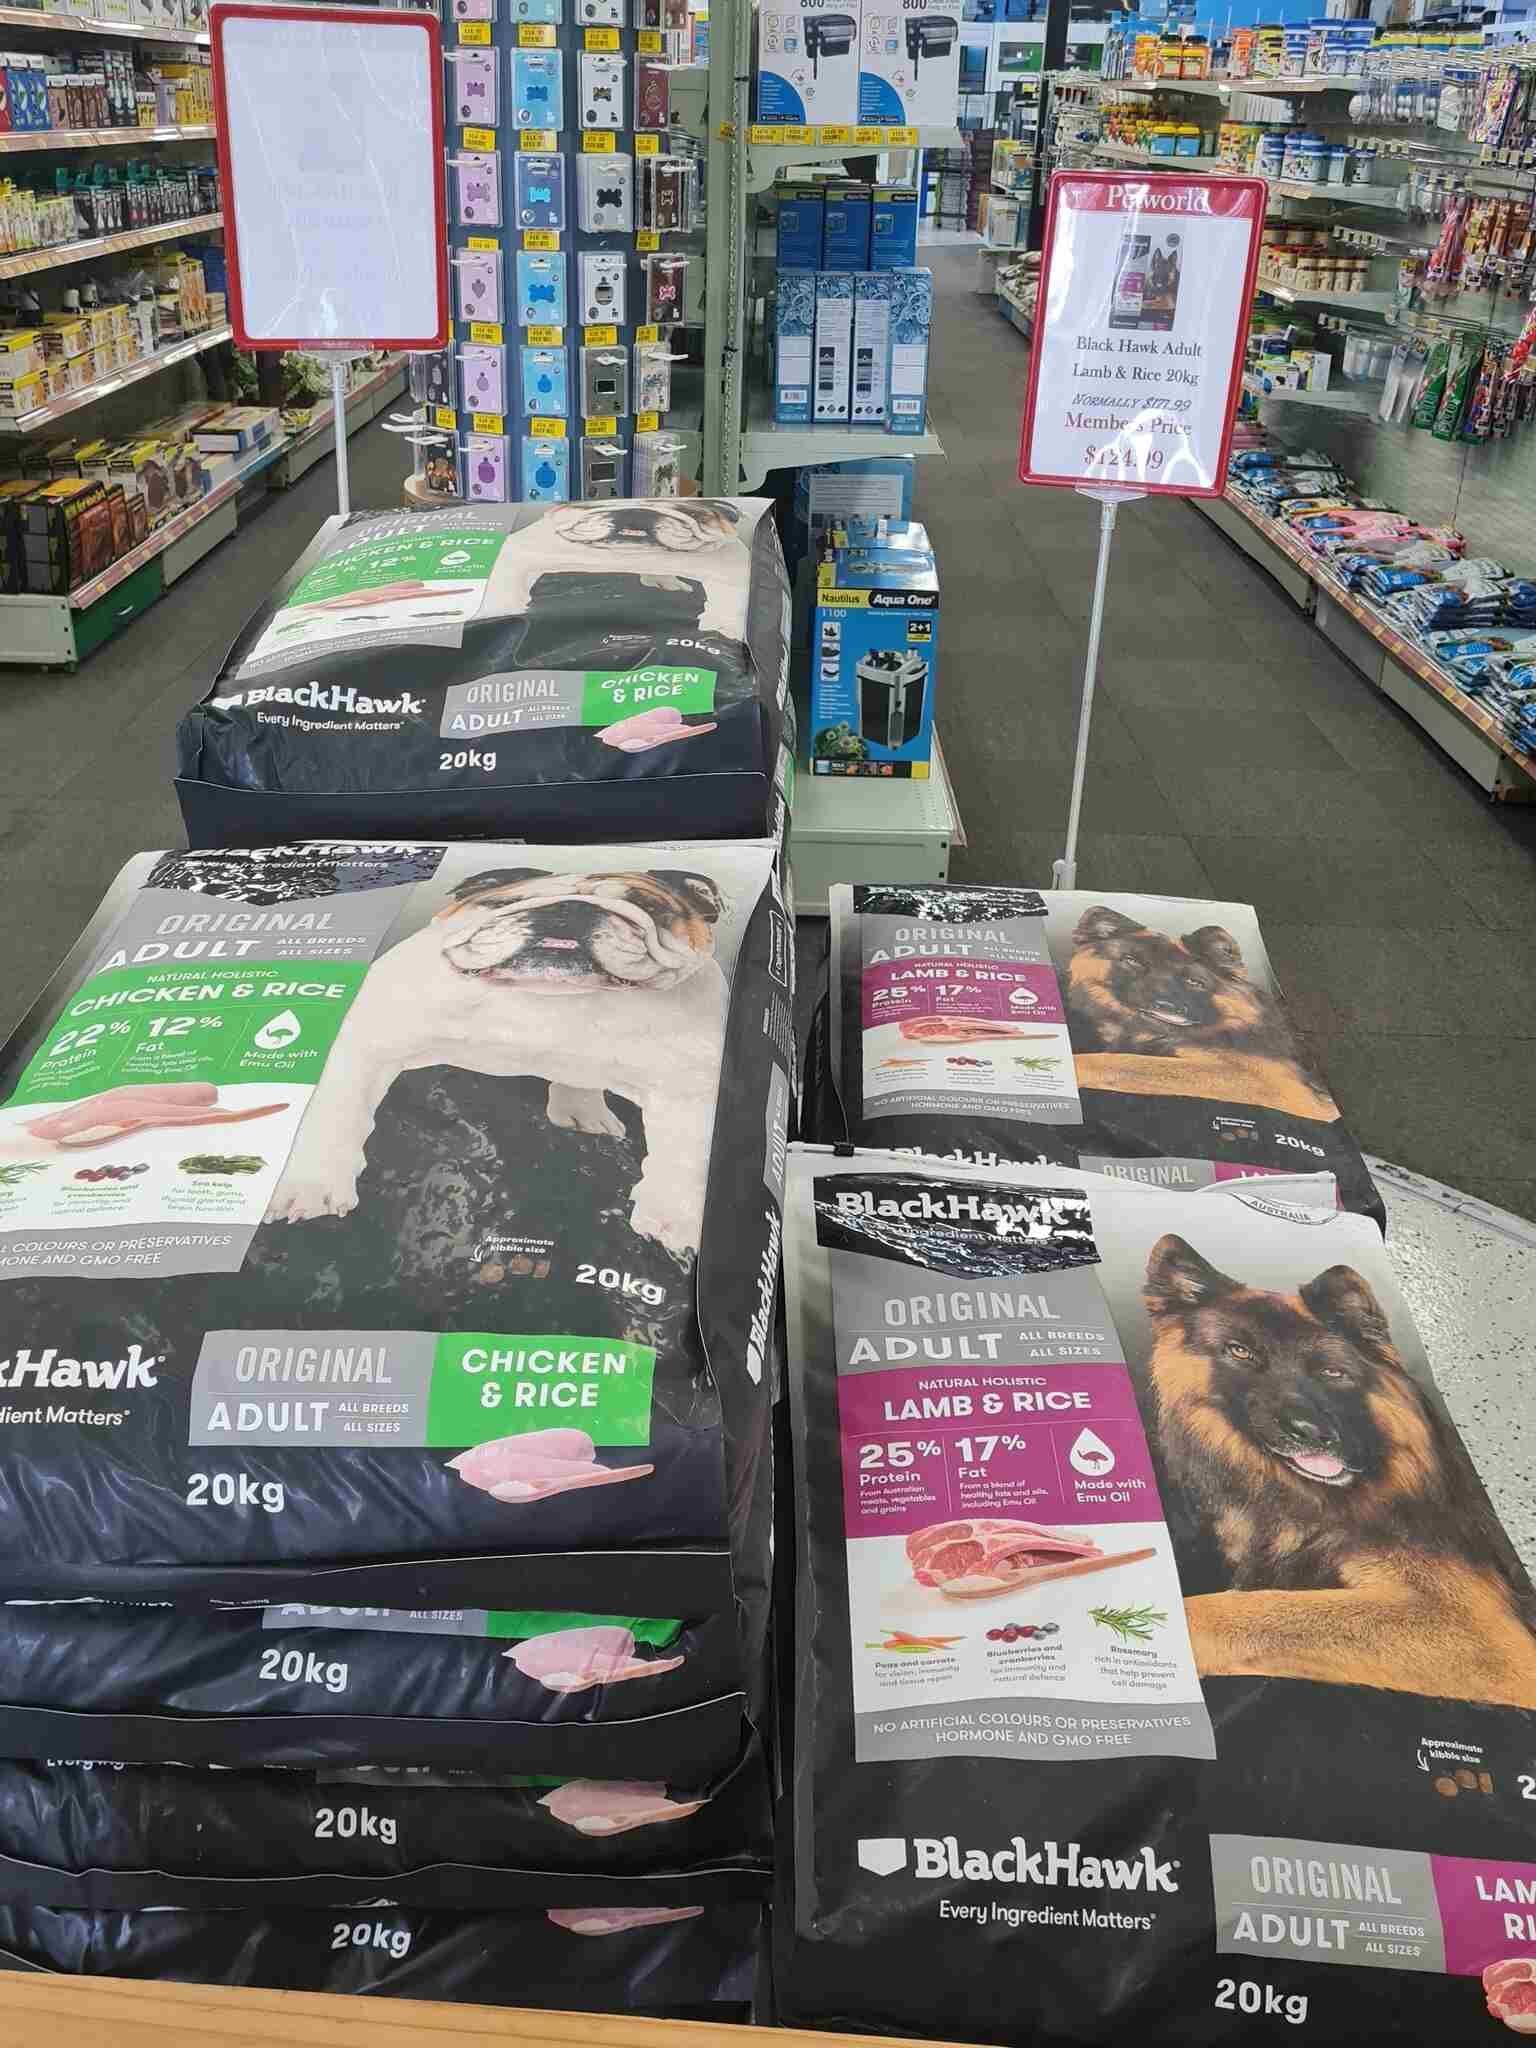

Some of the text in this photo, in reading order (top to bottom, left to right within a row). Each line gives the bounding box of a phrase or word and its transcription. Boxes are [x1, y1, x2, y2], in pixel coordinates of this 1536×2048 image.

[1076, 336, 1202, 357] Black Hawk Adult
[1072, 363, 1200, 386] Lamb & Rice 20kg
[1064, 412, 1192, 435] Membes Price
[440, 537, 497, 546] RICE
[821, 592, 861, 604] Nautilus
[872, 594, 905, 607] Aqua
[909, 622, 931, 632] 2+1
[665, 637, 721, 655] 20kg
[601, 671, 699, 690] CHICKEN
[245, 680, 423, 715] BlackHawk
[466, 679, 560, 705] ORIGINAL
[612, 684, 683, 703] & RICE
[256, 712, 401, 731] Every Ingredient Matters
[450, 709, 524, 732] ADULT
[439, 749, 497, 772] 20kg
[324, 860, 389, 869] matters
[155, 912, 336, 935] ORIGINAL
[895, 927, 1014, 945] ORIGINAL
[97, 935, 368, 975] ADULT ALL BREEDS
[277, 947, 354, 956] ALL SIZES
[869, 943, 973, 965] ADULT
[147, 969, 280, 984] NATURAL HOLISTIC
[890, 968, 1027, 982] LAMB & RICE
[70, 982, 348, 1017] CHICKEN & RICE
[872, 984, 927, 999] 25%
[935, 984, 982, 996] 17%
[871, 998, 912, 1009] Protein
[148, 1015, 224, 1038] 12%
[48, 1019, 133, 1058] 22%
[135, 1040, 165, 1054] Fat
[39, 1047, 97, 1071] Protein
[239, 1059, 297, 1069] Emu Oil
[243, 1049, 319, 1060] Made with
[1274, 1133, 1326, 1157] 20kg
[1103, 1163, 1194, 1185] ORIGINAL
[835, 1190, 1069, 1226] BlackHawk
[12, 1240, 88, 1253] COLOURS
[91, 1240, 115, 1251] OR
[119, 1234, 233, 1251] PRESERVATIVES
[484, 1235, 555, 1247] Approximate
[40, 1254, 76, 1265] AND
[79, 1254, 122, 1266] GMO
[124, 1253, 161, 1265] FREE
[575, 1263, 668, 1306] 20kg
[884, 1290, 1061, 1326] ORIGINAL
[849, 1330, 1105, 1365] ADULT ALL BREEDS
[1029, 1345, 1102, 1358] ALL SIZES
[235, 1346, 393, 1385] ORIGINAL
[461, 1347, 627, 1376] CHICKEN
[918, 1376, 1047, 1390] NATURAL HOLISTIC
[480, 1382, 599, 1408] & RICE
[884, 1391, 1093, 1421] LAMB & RICE
[45, 1405, 125, 1427] Matters
[206, 1401, 409, 1432] ADULT ALL BREEDS
[343, 1421, 401, 1433] ALL SIZES
[859, 1439, 941, 1470] 25%
[954, 1434, 1026, 1463] 17%
[859, 1470, 921, 1487] Protein
[958, 1466, 988, 1479] Fat
[185, 1472, 286, 1515] 20kg
[1073, 1477, 1146, 1491] Made with
[1076, 1491, 1130, 1504] Emu Oil
[409, 1609, 430, 1620] ALL
[259, 1648, 349, 1694] 20kg
[873, 1711, 1192, 1734] NO ARTIFICIAL COLOURS OR PRESERVATIVES
[935, 1729, 1133, 1747] HORMONE AND GMO FREE
[1421, 1736, 1484, 1754] Approximate
[1429, 1749, 1481, 1764] kibble size
[314, 1807, 398, 1846] 20kg
[913, 1836, 1179, 1893] BlackHawk
[1249, 1855, 1402, 1906] ORIGINAL
[939, 1899, 1151, 1930] Every Ingredient Matters
[330, 1922, 412, 1959] 20kg
[1233, 1911, 1425, 1950] ADULT ALL BREEDS
[1365, 1942, 1422, 1957] ALL SIZES
[1214, 1978, 1309, 2024] 20kg
